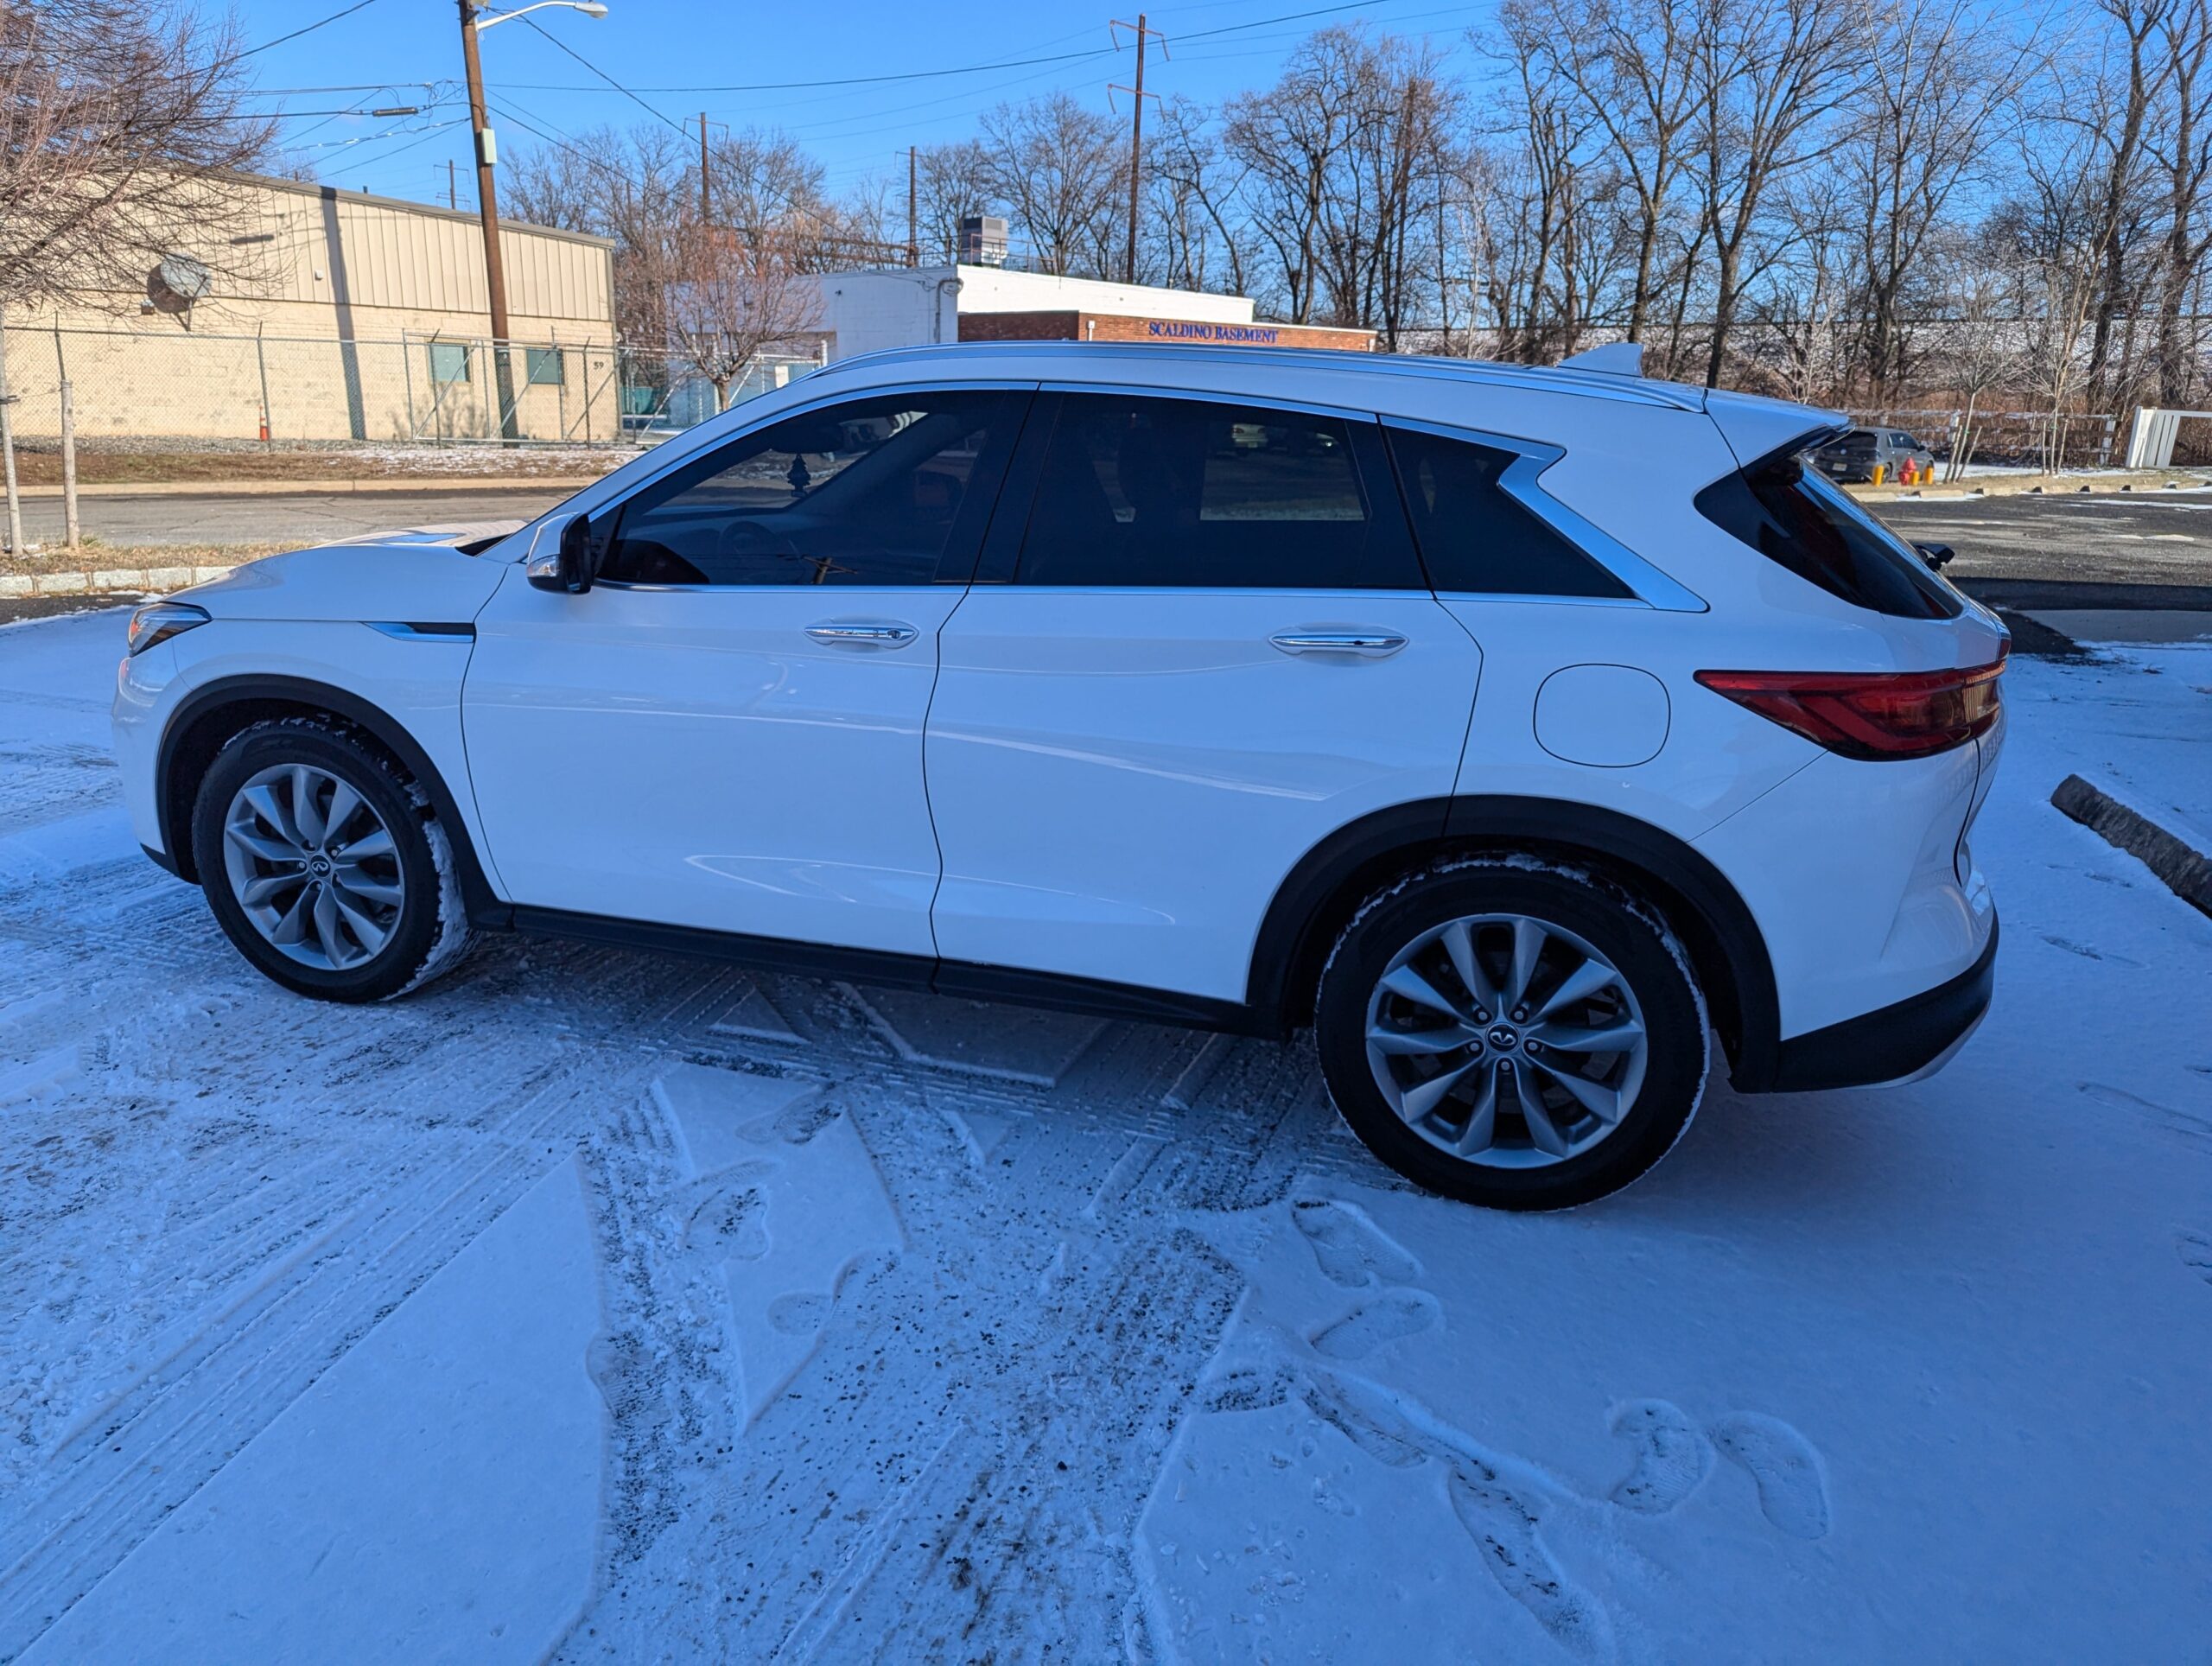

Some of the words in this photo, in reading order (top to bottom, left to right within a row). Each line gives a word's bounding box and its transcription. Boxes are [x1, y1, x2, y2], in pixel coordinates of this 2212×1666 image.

[1148, 321, 1212, 340] SCALDINO
[1215, 325, 1279, 343] BASEMENT
[594, 361, 604, 370] 59
